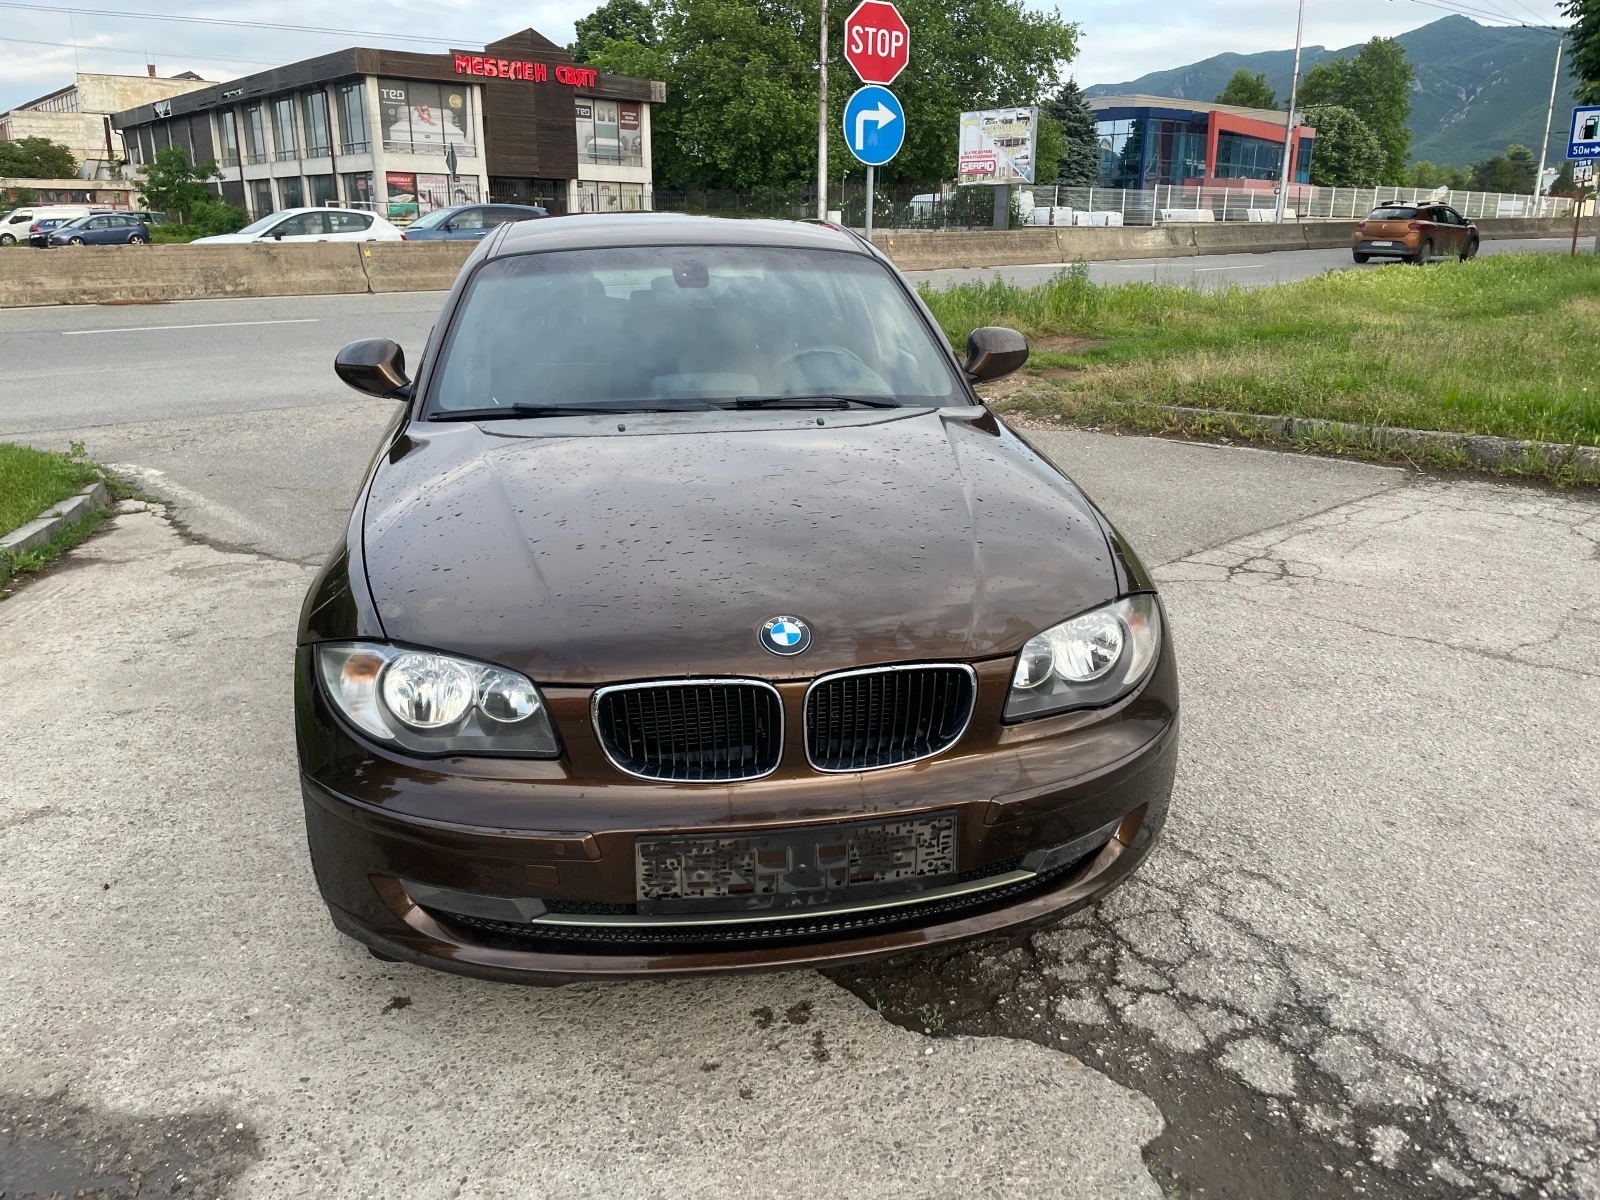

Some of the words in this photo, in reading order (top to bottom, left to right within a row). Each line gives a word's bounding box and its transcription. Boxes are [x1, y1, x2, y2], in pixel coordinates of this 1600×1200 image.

[851, 25, 904, 58] STOP
[455, 54, 547, 83] МЕБЕЛЕН
[555, 66, 597, 87] СВЯТ
[764, 616, 805, 630] BMW
